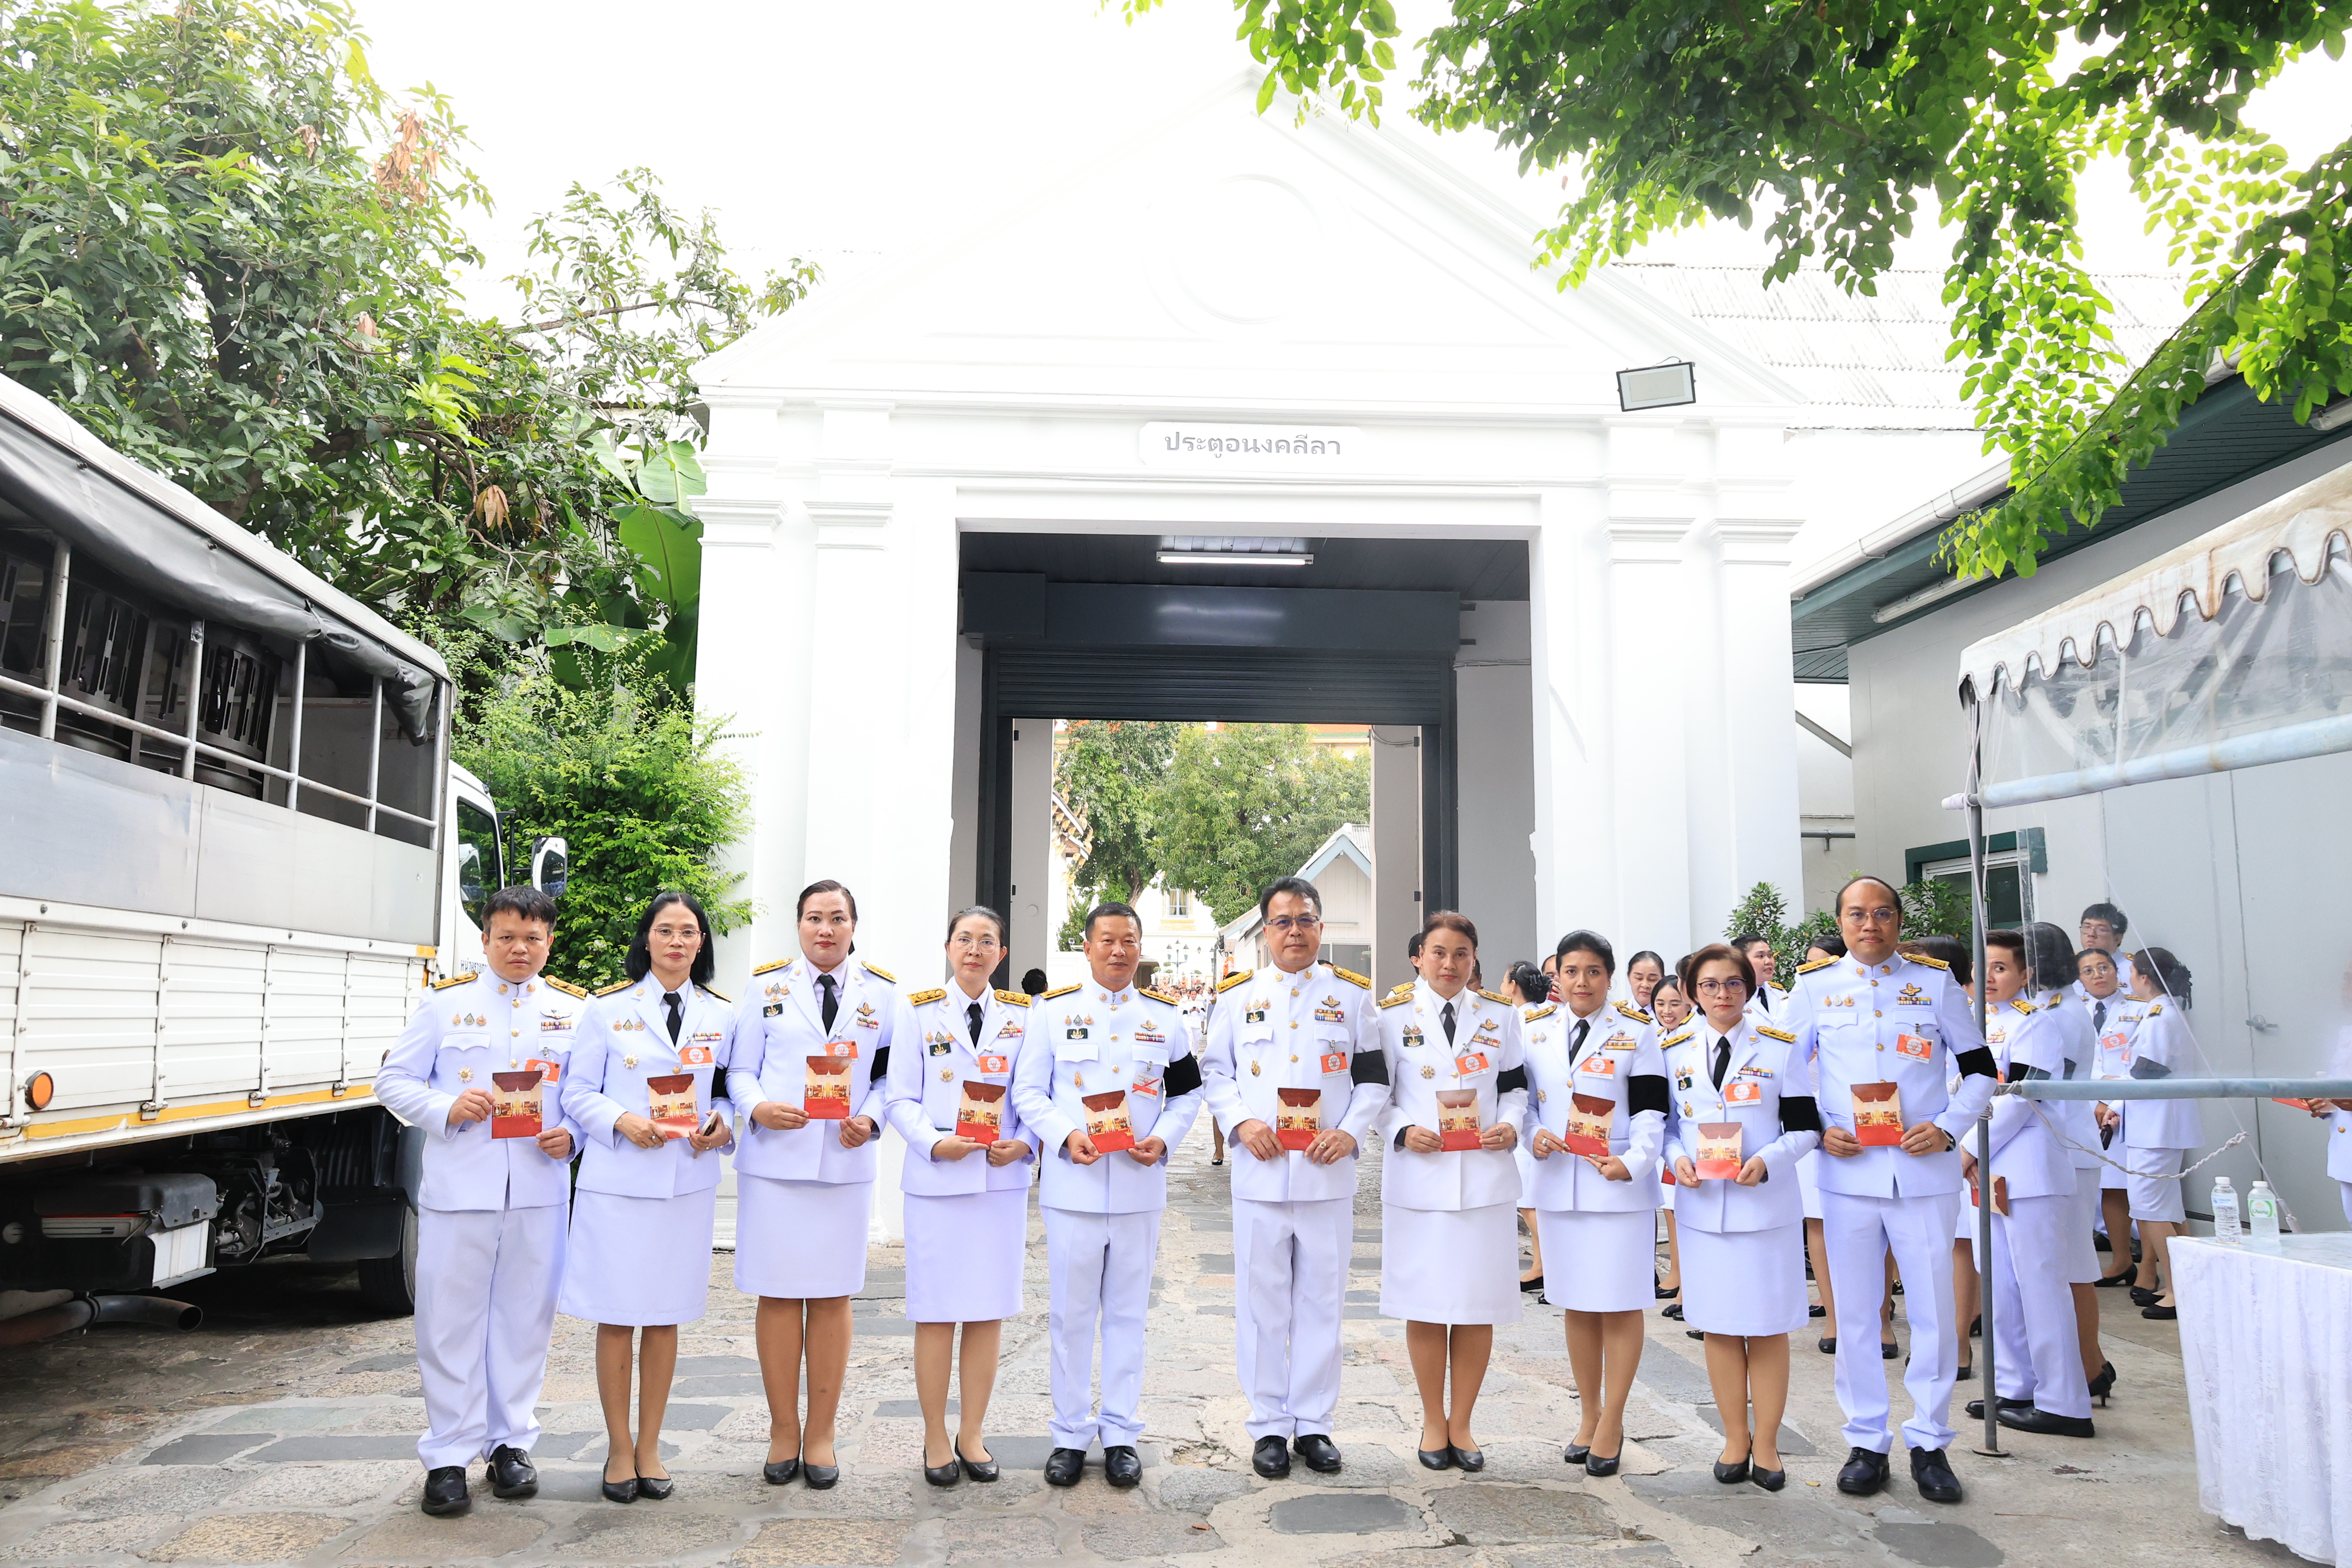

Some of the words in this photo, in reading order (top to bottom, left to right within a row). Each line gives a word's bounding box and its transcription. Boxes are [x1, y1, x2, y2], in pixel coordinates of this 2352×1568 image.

[1164, 432, 1341, 458] ประตูอนงคลีลา
[460, 958, 489, 974] หน่วยราชกา
